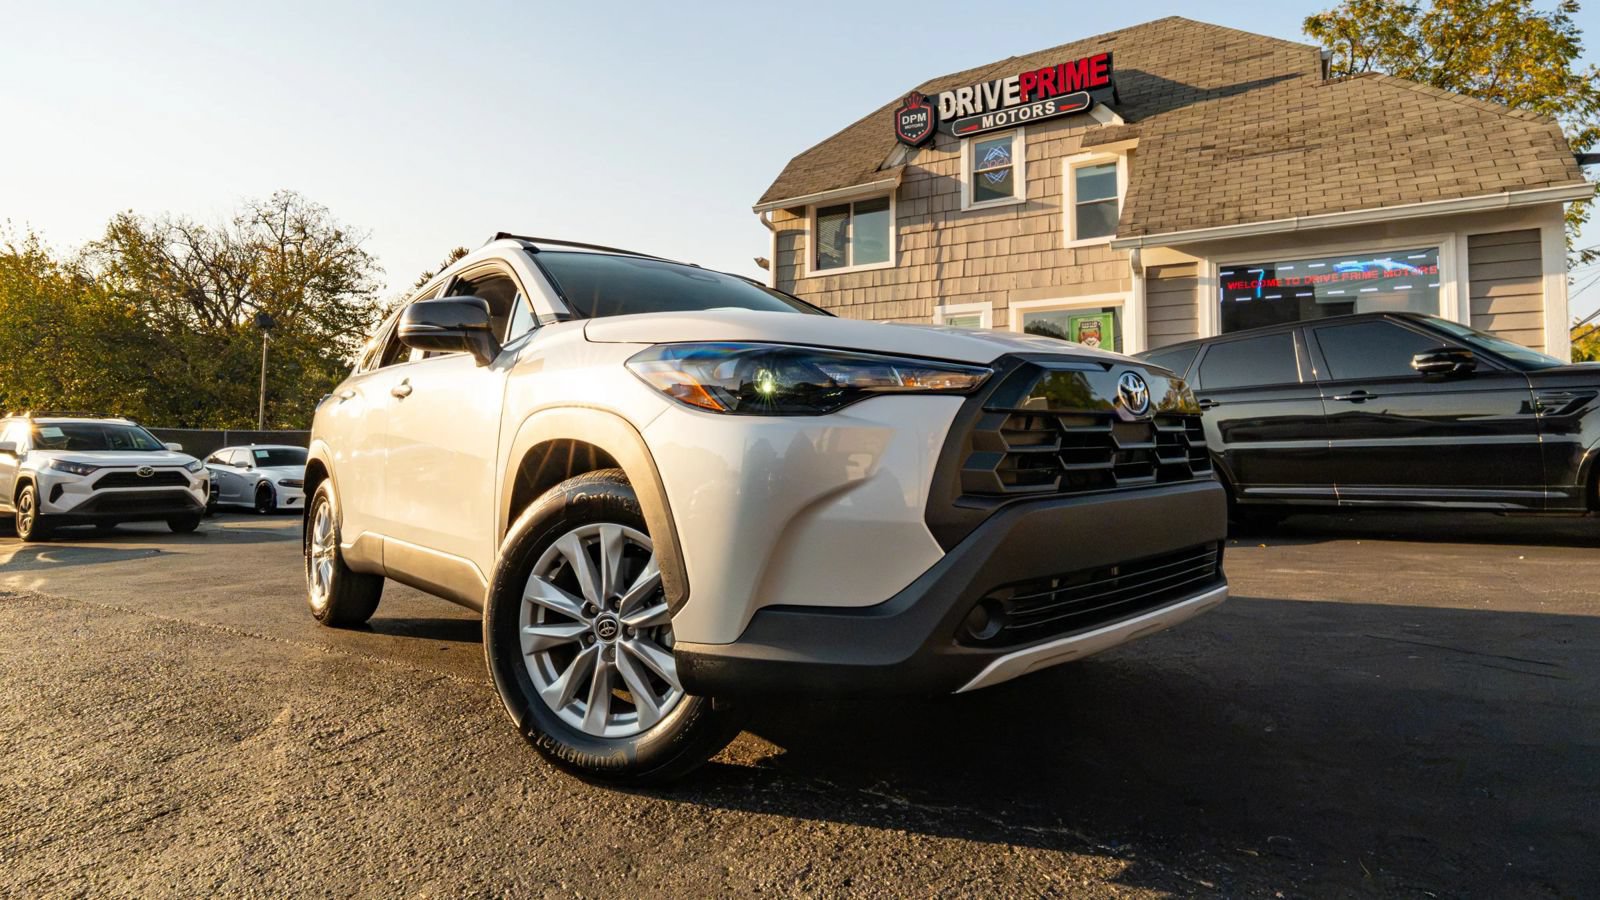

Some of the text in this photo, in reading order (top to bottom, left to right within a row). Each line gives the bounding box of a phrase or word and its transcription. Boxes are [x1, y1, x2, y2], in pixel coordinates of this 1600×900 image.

[902, 112, 927, 125] DPM
[982, 102, 1056, 128] MOTORS
[1227, 278, 1282, 290] WELCOME
[1285, 276, 1300, 285] TO
[1304, 272, 1338, 284] DRIVE
[1341, 270, 1379, 281] PRIME
